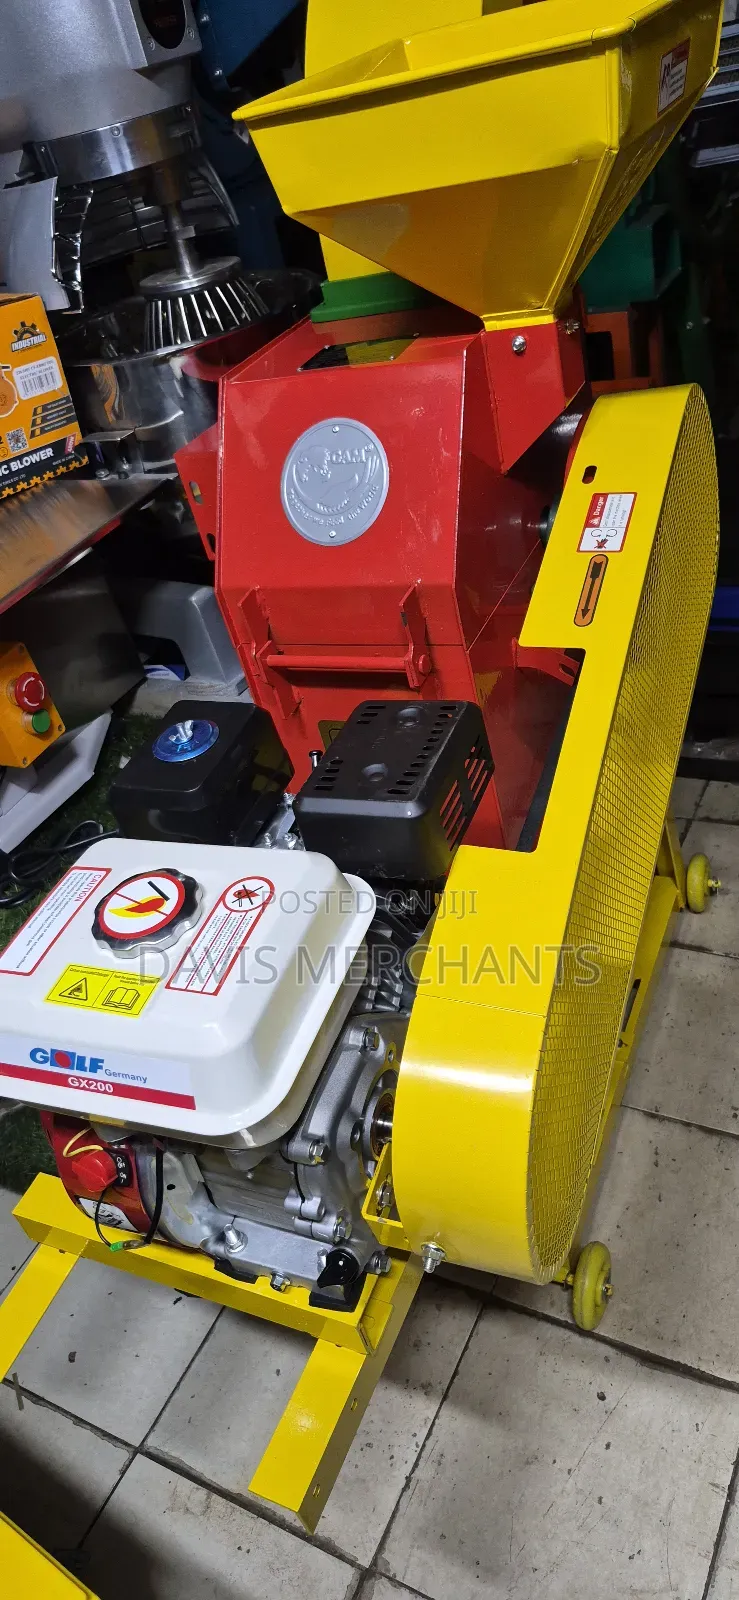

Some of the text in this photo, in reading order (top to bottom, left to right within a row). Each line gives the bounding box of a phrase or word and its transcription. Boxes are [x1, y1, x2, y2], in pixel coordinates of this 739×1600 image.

[12, 334, 46, 352] INDUSTRIAL
[10, 447, 54, 472] BLOWER
[593, 496, 605, 516] Danger
[74, 874, 102, 902] CAUTION
[29, 1047, 148, 1084] GOLF Germany
[67, 1076, 114, 1093] GX200
